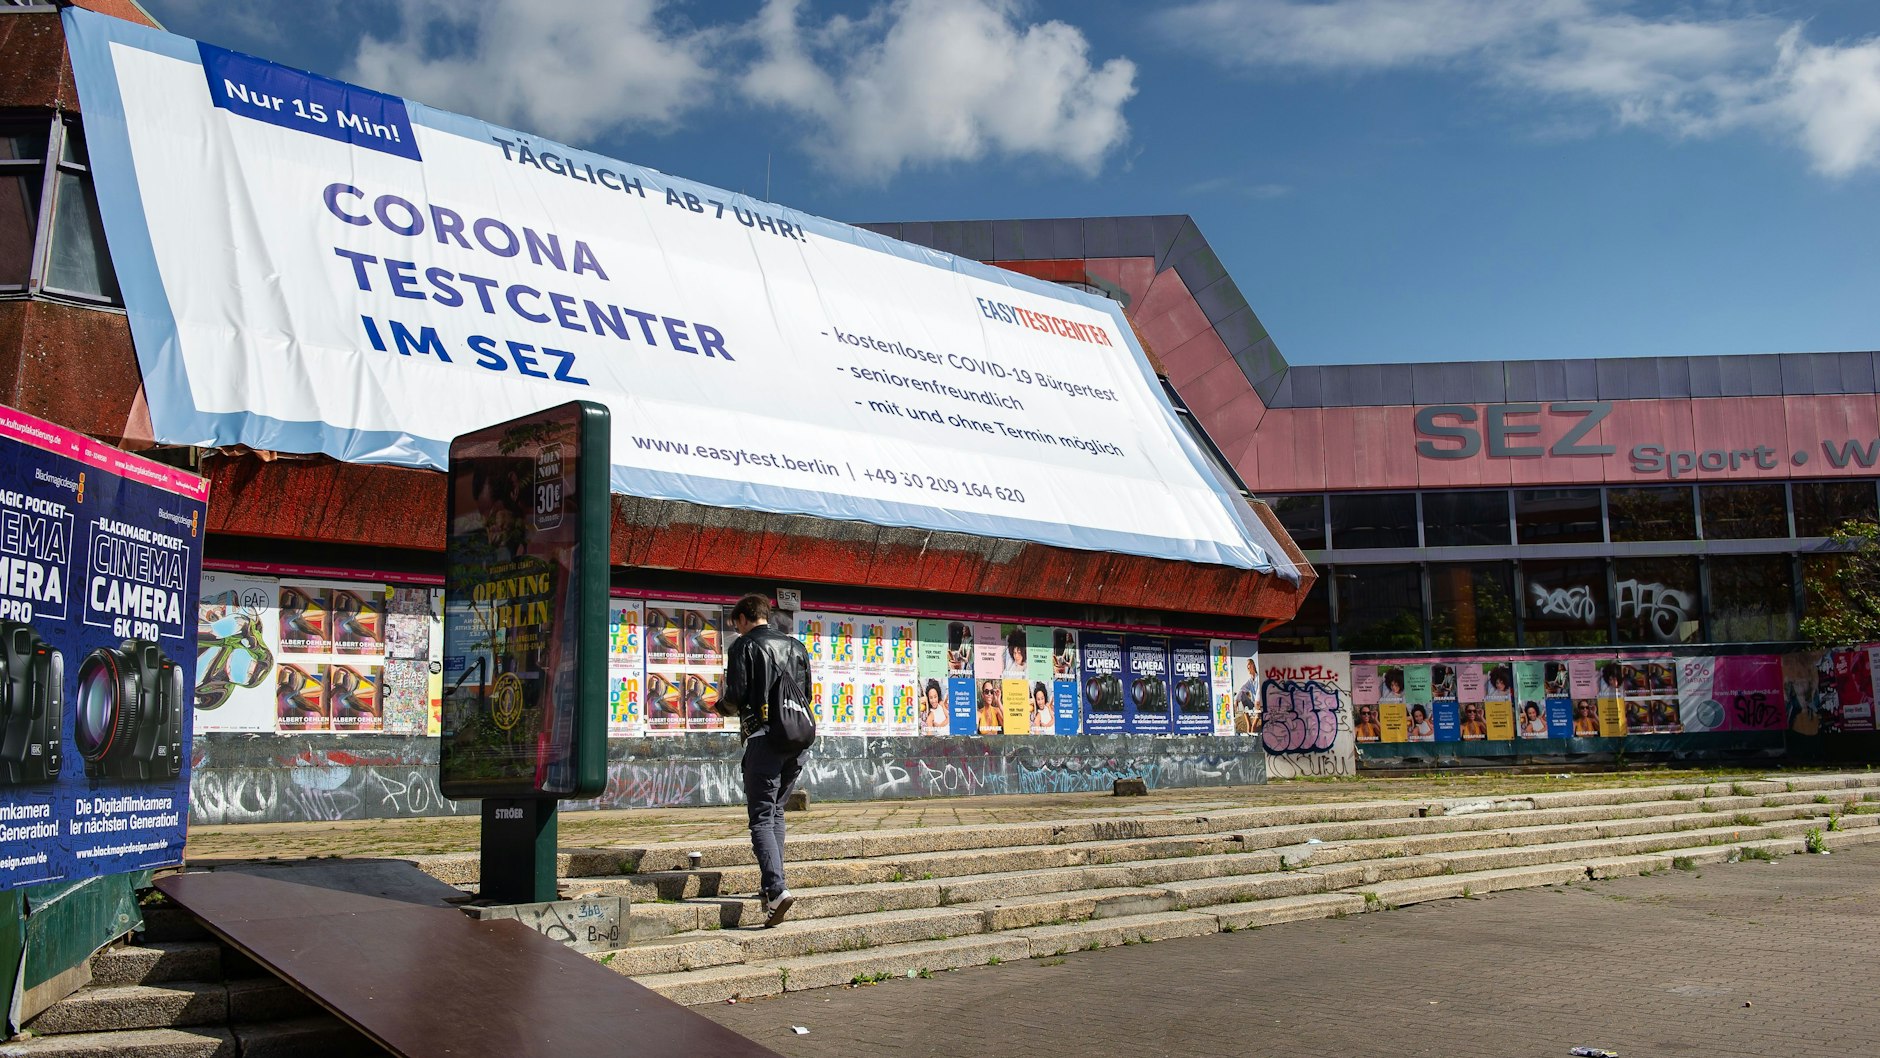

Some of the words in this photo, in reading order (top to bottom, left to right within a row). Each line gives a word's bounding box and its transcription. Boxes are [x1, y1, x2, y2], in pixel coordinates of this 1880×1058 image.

[224, 78, 283, 111] Nur
[290, 97, 326, 125] 15
[336, 110, 402, 143] Min!
[492, 136, 646, 199] TÄGLICH
[665, 187, 704, 214] AB
[707, 200, 724, 219] 7
[733, 209, 808, 243] UHR!
[323, 183, 610, 282] CORONA
[334, 247, 736, 361] TESTCENTER
[977, 297, 1113, 348] EASYTESTCENTER
[360, 315, 452, 363] IM
[467, 335, 590, 387] SEZ
[834, 327, 944, 367] kostenloser
[947, 353, 1032, 385] COVID-19
[1035, 372, 1119, 404] Bürgertest
[850, 364, 1025, 412] seniorenfreundlich
[868, 397, 903, 420] mit
[907, 404, 945, 426] und
[948, 411, 993, 435] ohne
[994, 421, 1056, 446] Termin
[1059, 432, 1124, 458] möglich
[1415, 402, 1616, 459] SEZ
[538, 451, 560, 466] JOIN
[632, 434, 839, 477] www.easytest.berlin
[863, 468, 897, 485] +49
[929, 475, 958, 496] 209
[963, 480, 993, 500] 164
[995, 485, 1025, 504] 620
[1631, 443, 1778, 478] Sport
[35, 468, 79, 493] Blackmagicdesign
[538, 463, 560, 479] NOW
[25, 497, 66, 519] POCKET
[158, 508, 193, 528] Blackmagicdesign
[1, 509, 66, 564] EMA
[99, 516, 152, 544] BLACKMAGIC
[152, 533, 183, 551] POCKET
[93, 534, 183, 590] CINEMA
[202, 573, 215, 582] ing
[472, 572, 550, 601] OPENING
[90, 575, 181, 625] CAMERA
[244, 592, 266, 611] PAF
[0, 601, 32, 623] PRO
[114, 619, 131, 638] 6K
[134, 623, 158, 641] PRO
[1087, 650, 1120, 659] CINEMA
[1087, 659, 1120, 668] CAMERA
[1132, 661, 1164, 670] CAMERA
[1176, 663, 1206, 672] CAMERA
[1685, 664, 1710, 676] 5%
[76, 799, 92, 816] Die
[94, 797, 172, 815] Digitalfilmkamera
[495, 808, 523, 819] STRÖER
[0, 820, 59, 842] Generation!
[84, 816, 128, 832] nächsten
[130, 812, 178, 829] Generation!
[76, 839, 168, 859] www.blackmagicdesign.com/de
